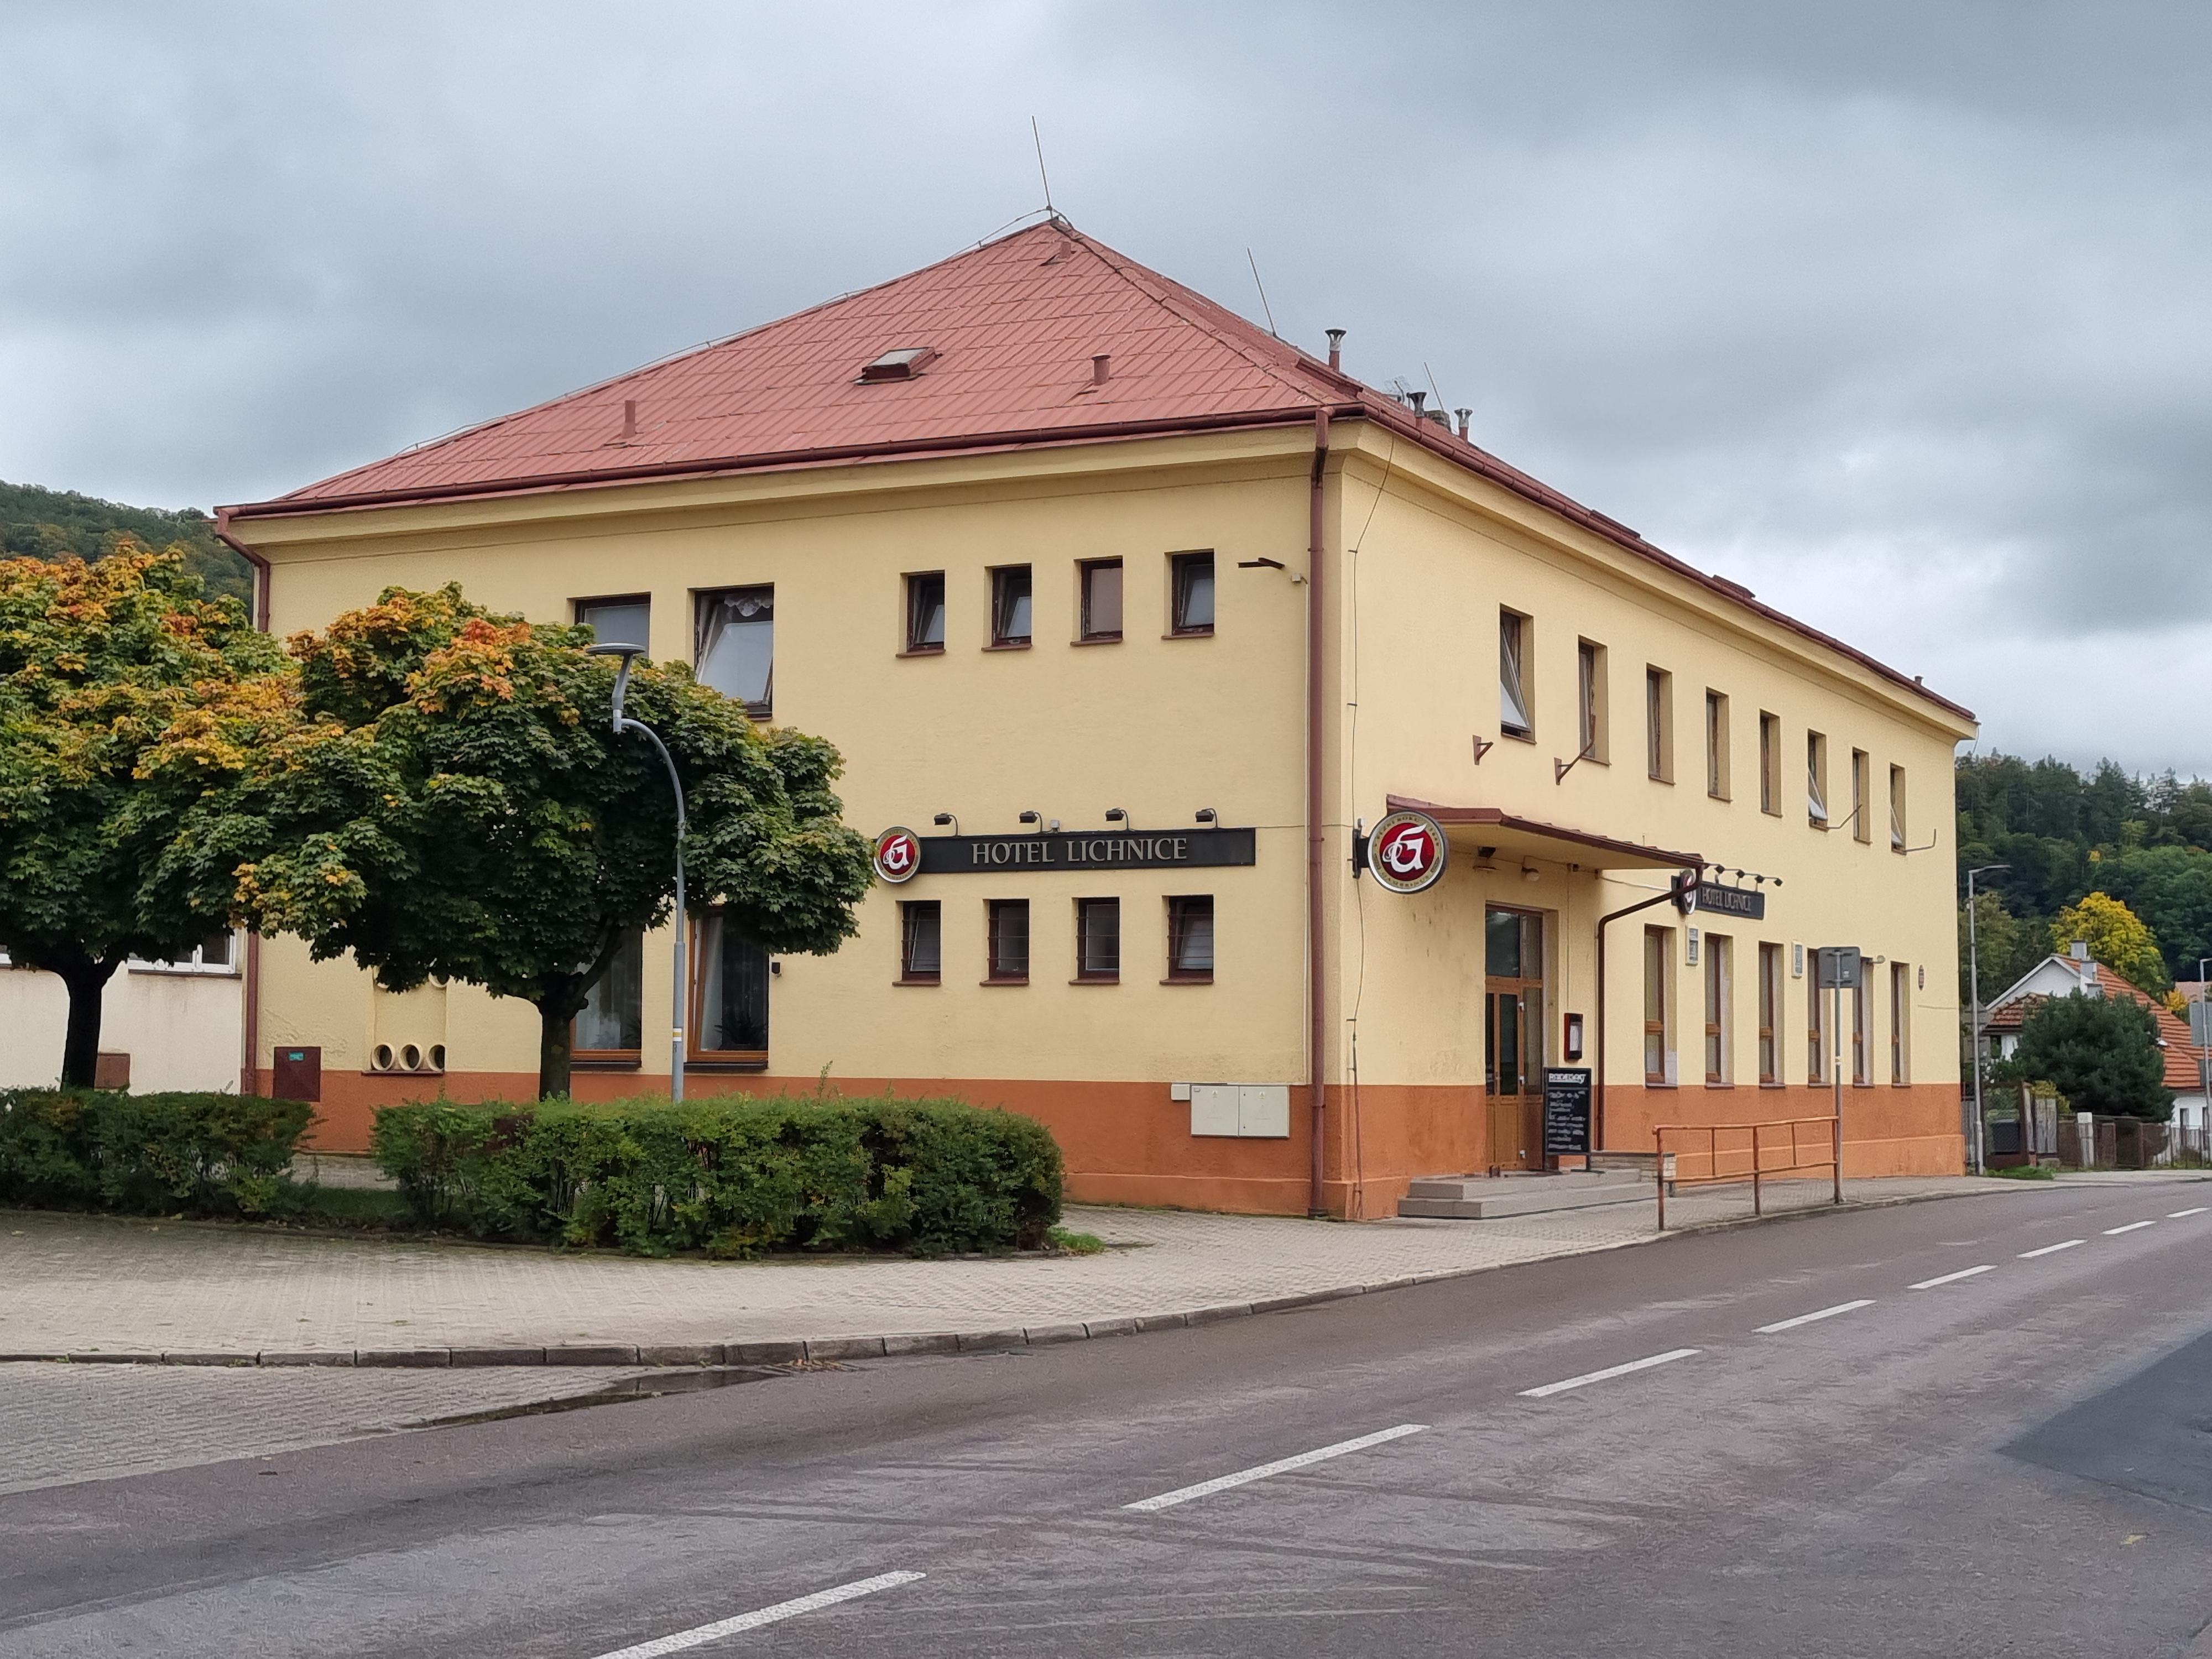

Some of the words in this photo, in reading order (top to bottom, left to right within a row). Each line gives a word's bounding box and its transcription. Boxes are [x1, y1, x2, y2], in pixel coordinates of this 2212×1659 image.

[971, 842, 1055, 864] HOTEL
[1066, 838, 1187, 862] LICHNICE
[1702, 887, 1723, 906] HOTEL
